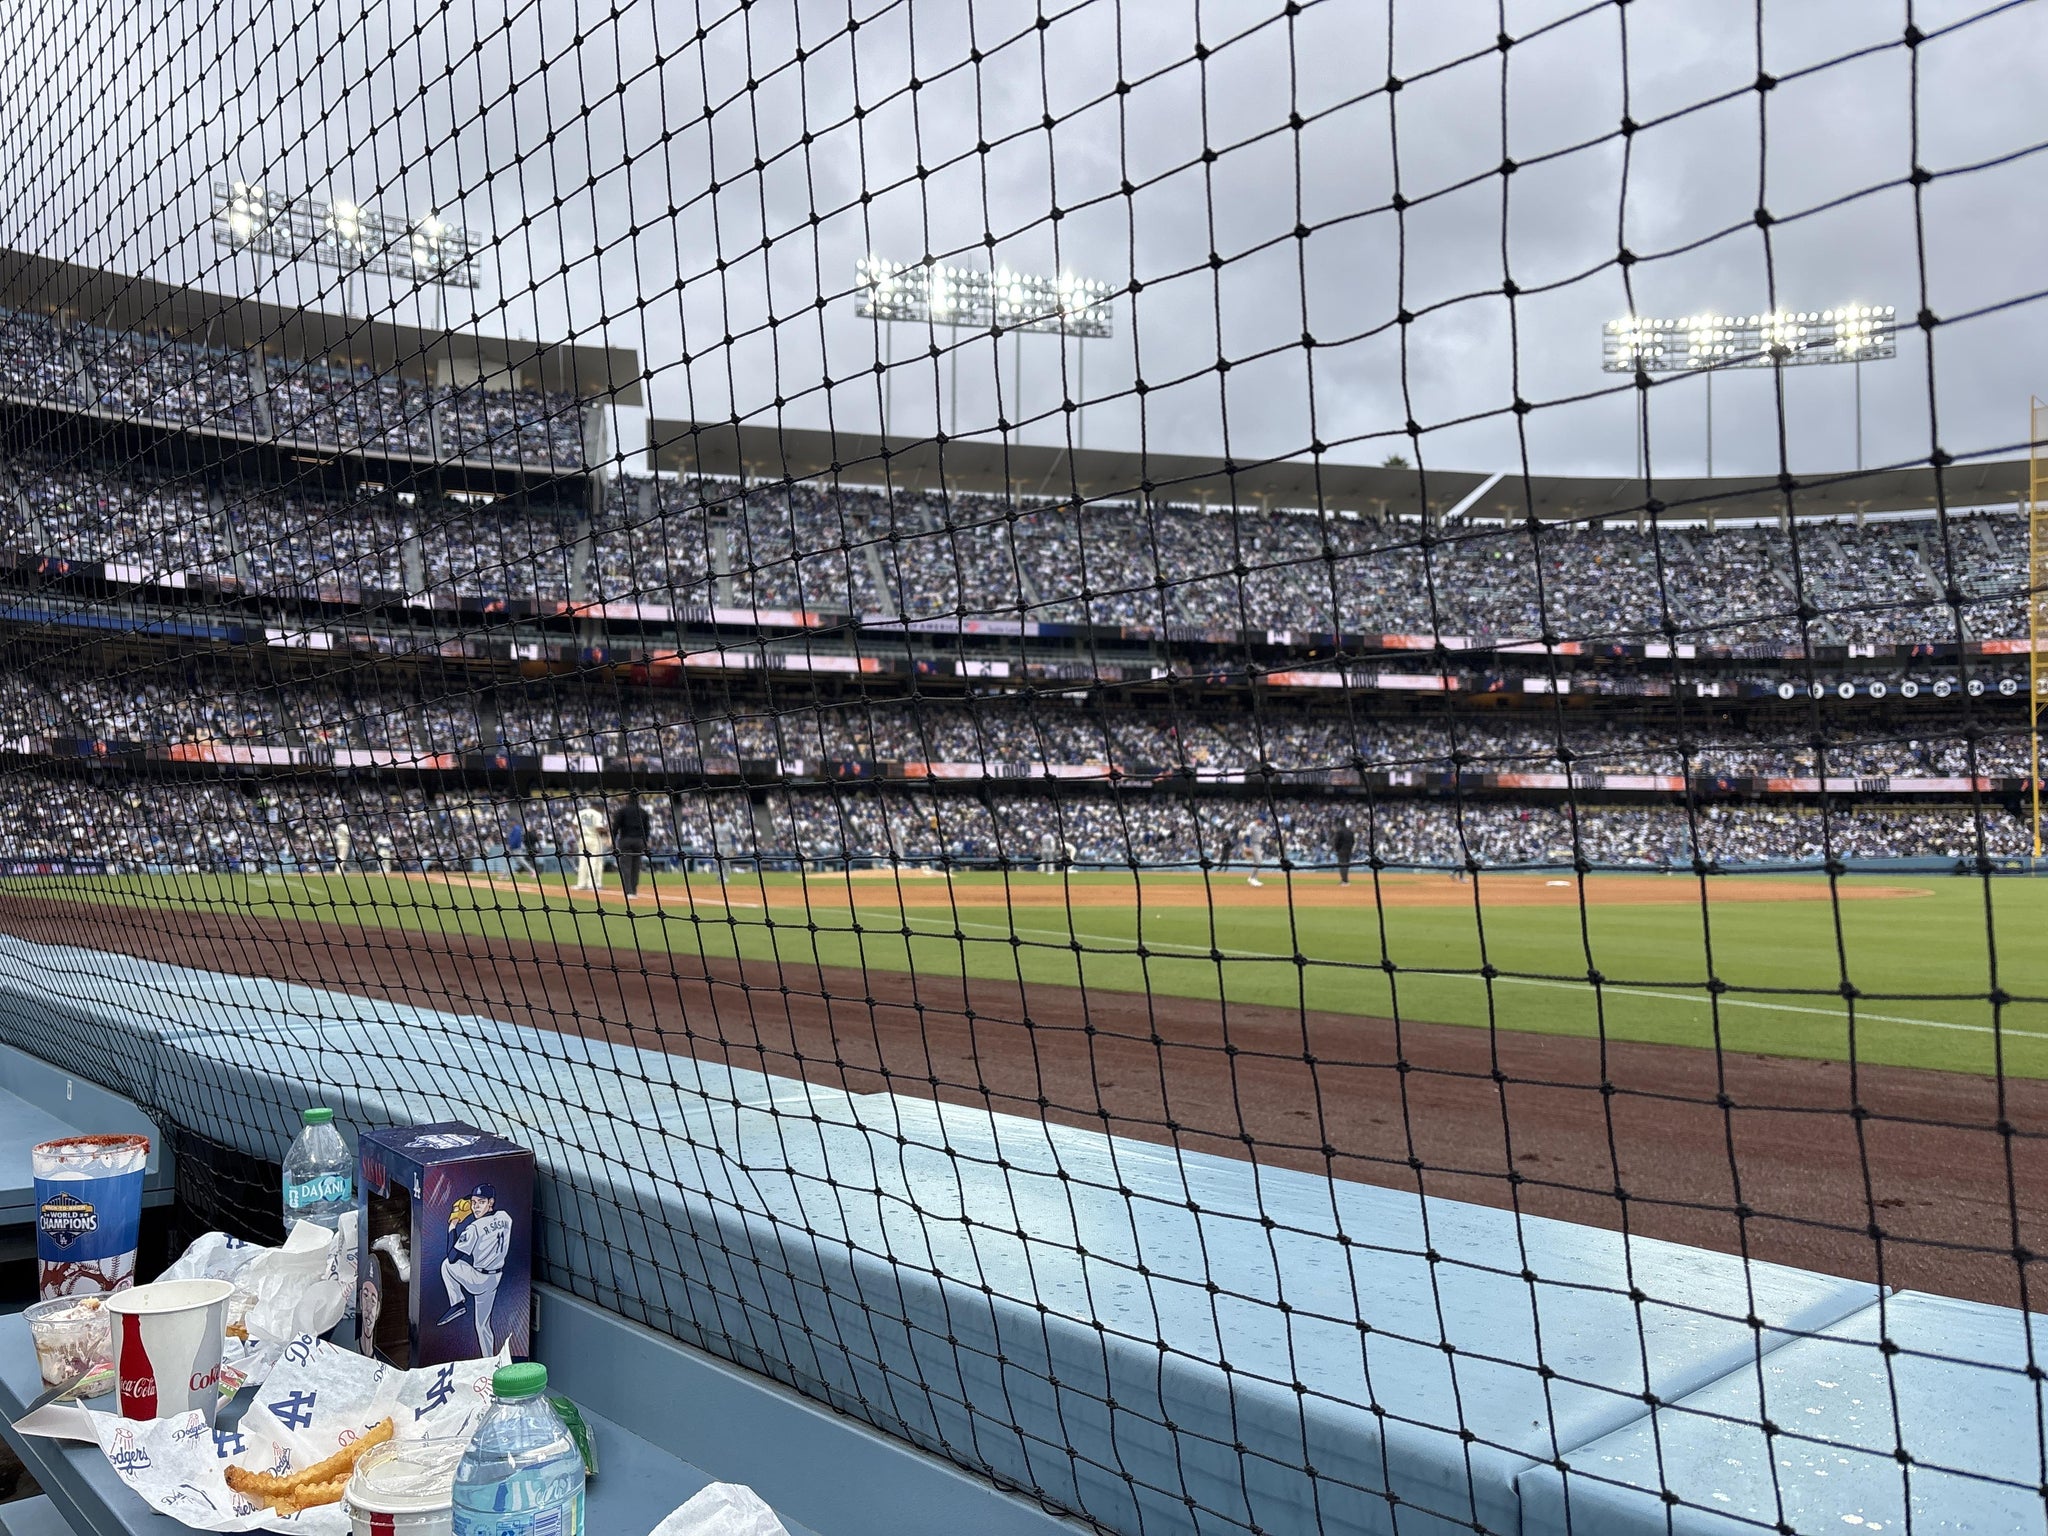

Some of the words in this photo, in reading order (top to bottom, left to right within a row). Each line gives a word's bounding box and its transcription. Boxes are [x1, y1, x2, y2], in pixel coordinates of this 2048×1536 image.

[301, 1180, 343, 1200] DASANI
[40, 1215, 97, 1230] CHAMPIONS
[496, 1231, 504, 1253] 11
[109, 1446, 152, 1475] odgers
